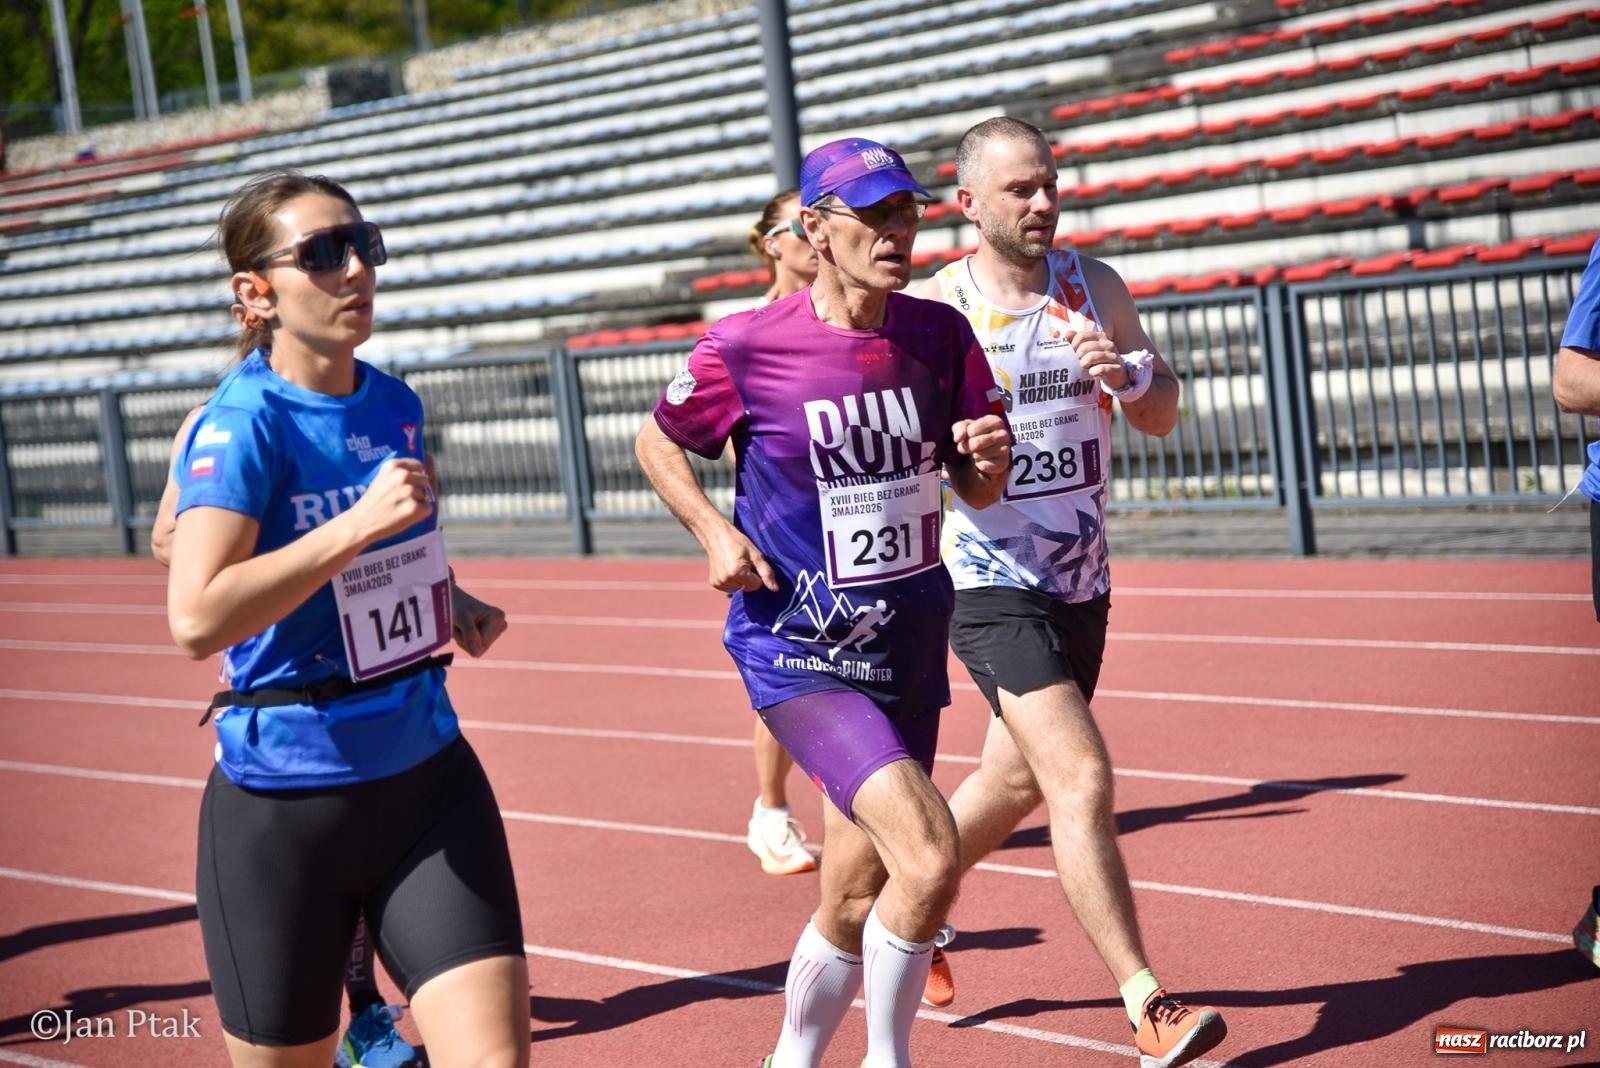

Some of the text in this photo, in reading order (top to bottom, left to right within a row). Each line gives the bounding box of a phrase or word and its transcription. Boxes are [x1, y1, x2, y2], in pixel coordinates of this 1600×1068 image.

[1019, 368, 1068, 389] XII BIEG
[1019, 378, 1095, 405] KOZIOŁKÓW
[803, 387, 922, 478] RUN
[1020, 421, 1038, 432] BIEG
[1040, 418, 1052, 429] BEZ
[1054, 413, 1079, 426] GRANIC
[1013, 447, 1077, 486] 238
[830, 483, 920, 506] XVIII BIEG BEZ GRANIC
[831, 503, 883, 517] 3MAJA2026
[851, 523, 911, 566] 231
[340, 546, 427, 584] XVIII BIEG BEZ GRANIC
[343, 573, 393, 598] 3MAJA2026
[368, 595, 422, 652] 141
